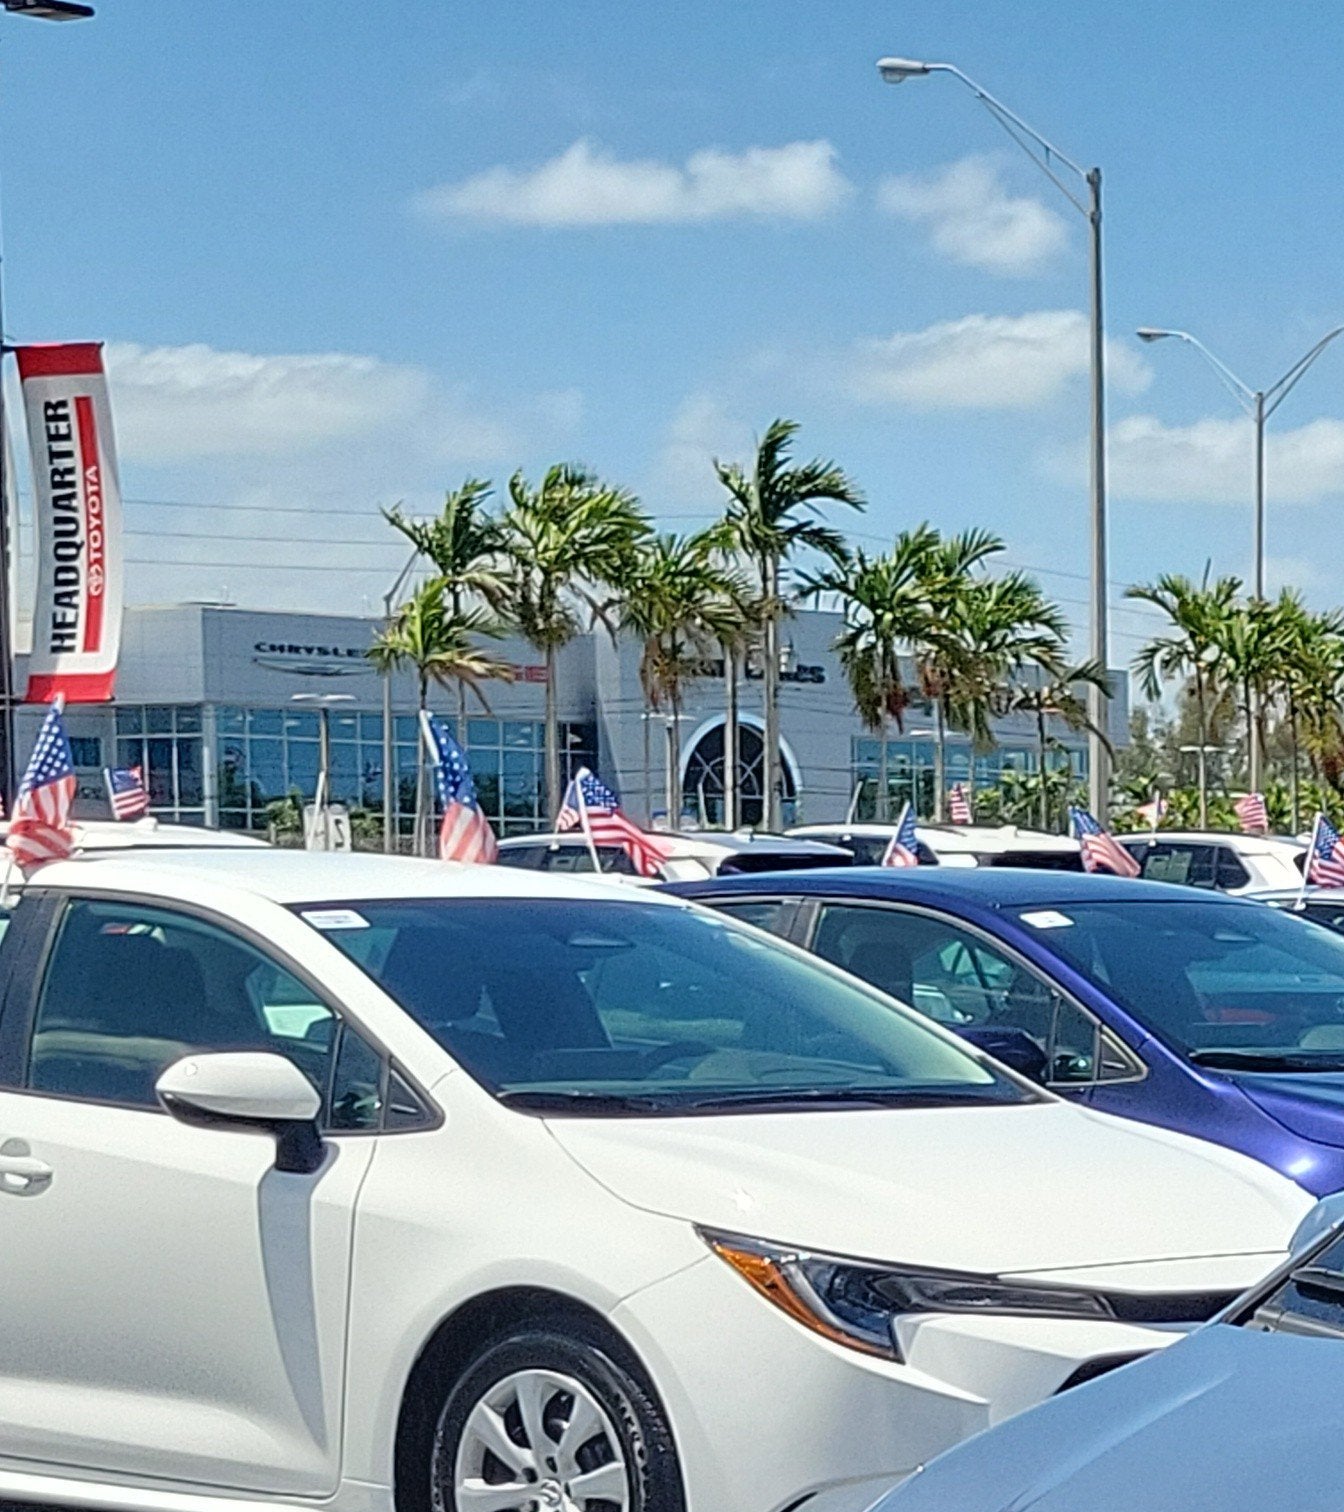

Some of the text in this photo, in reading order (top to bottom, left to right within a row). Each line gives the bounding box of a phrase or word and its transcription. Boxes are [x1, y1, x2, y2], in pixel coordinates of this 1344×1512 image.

[44, 398, 85, 654] HEADQUARTER
[85, 465, 104, 565] TOYOTA
[254, 641, 367, 658] CHRYSLE
